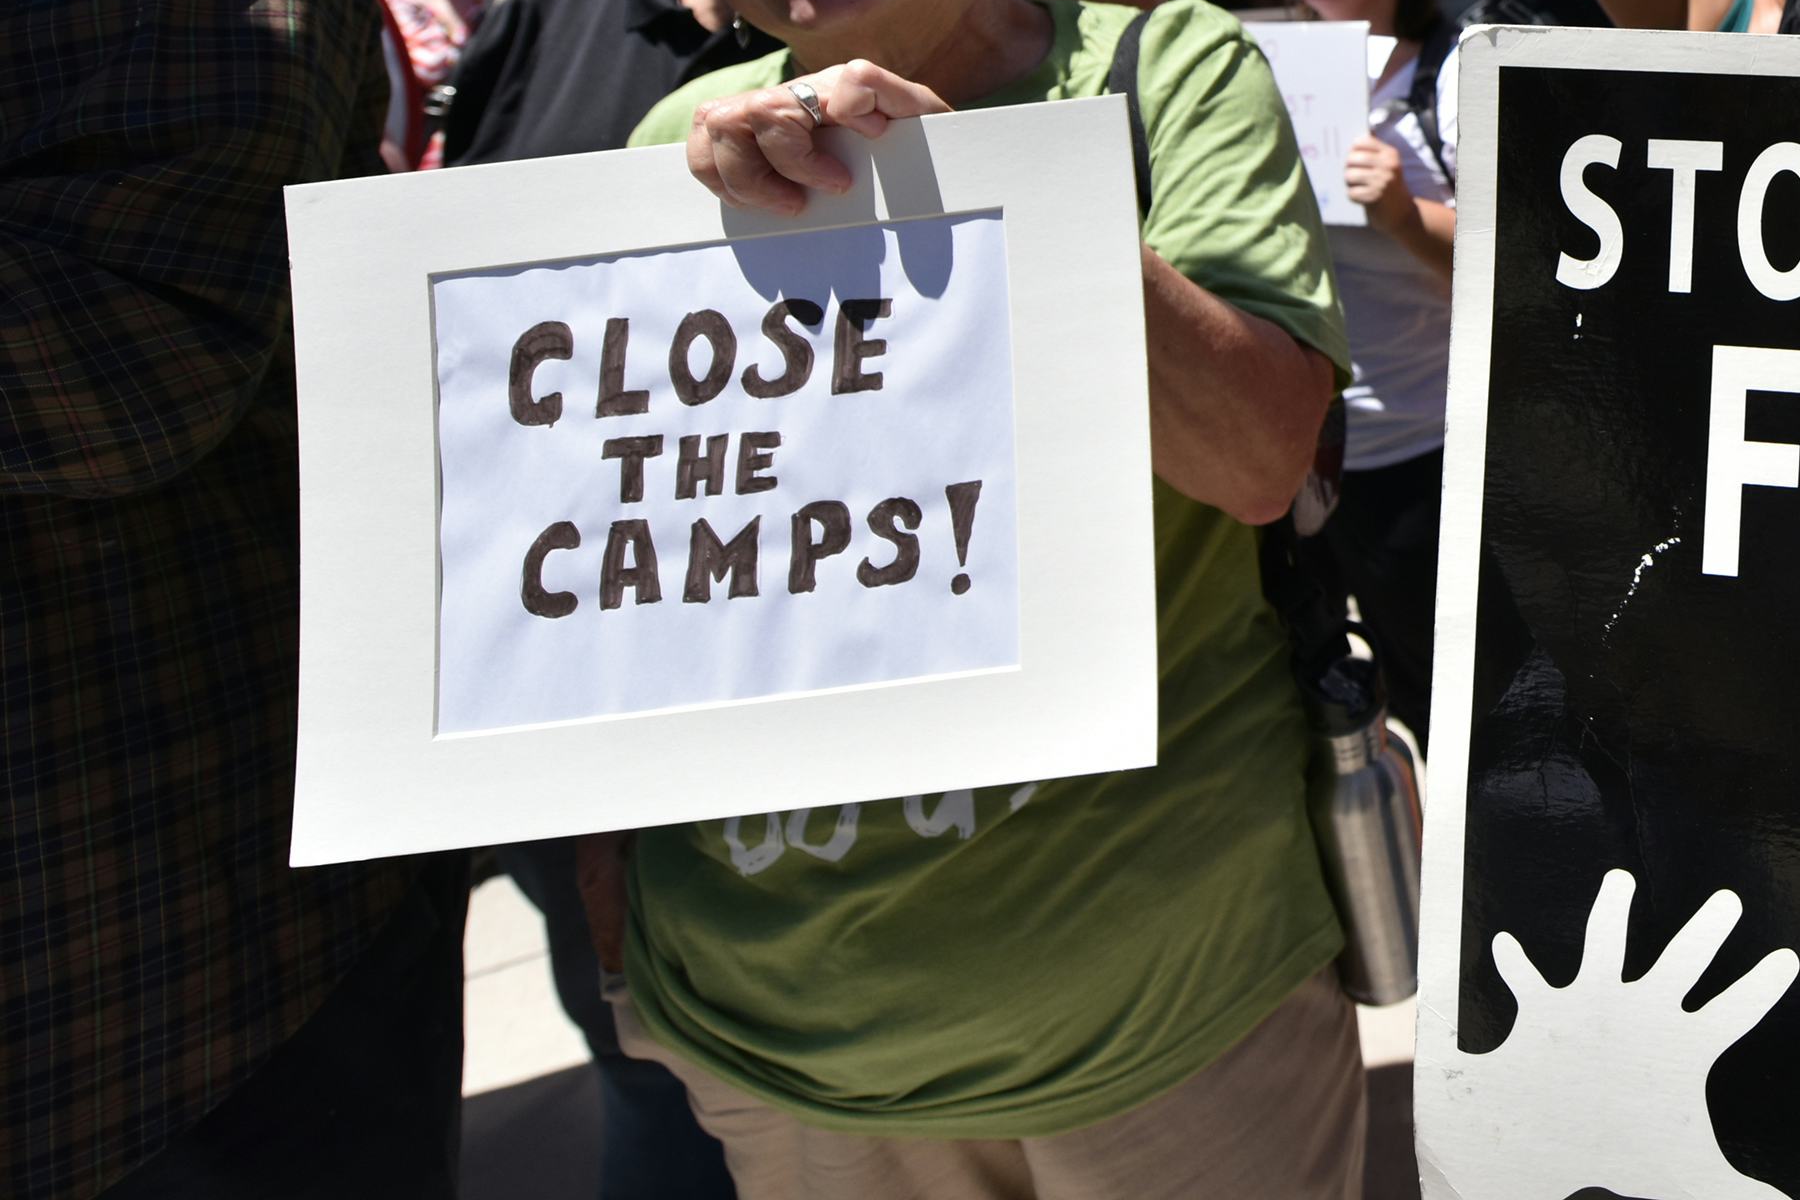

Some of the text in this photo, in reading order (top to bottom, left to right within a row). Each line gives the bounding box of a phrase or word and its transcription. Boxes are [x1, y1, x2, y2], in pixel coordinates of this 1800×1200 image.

[508, 298, 893, 427] CLOSE
[601, 430, 781, 503] THE
[521, 480, 983, 619] CAMPS!
